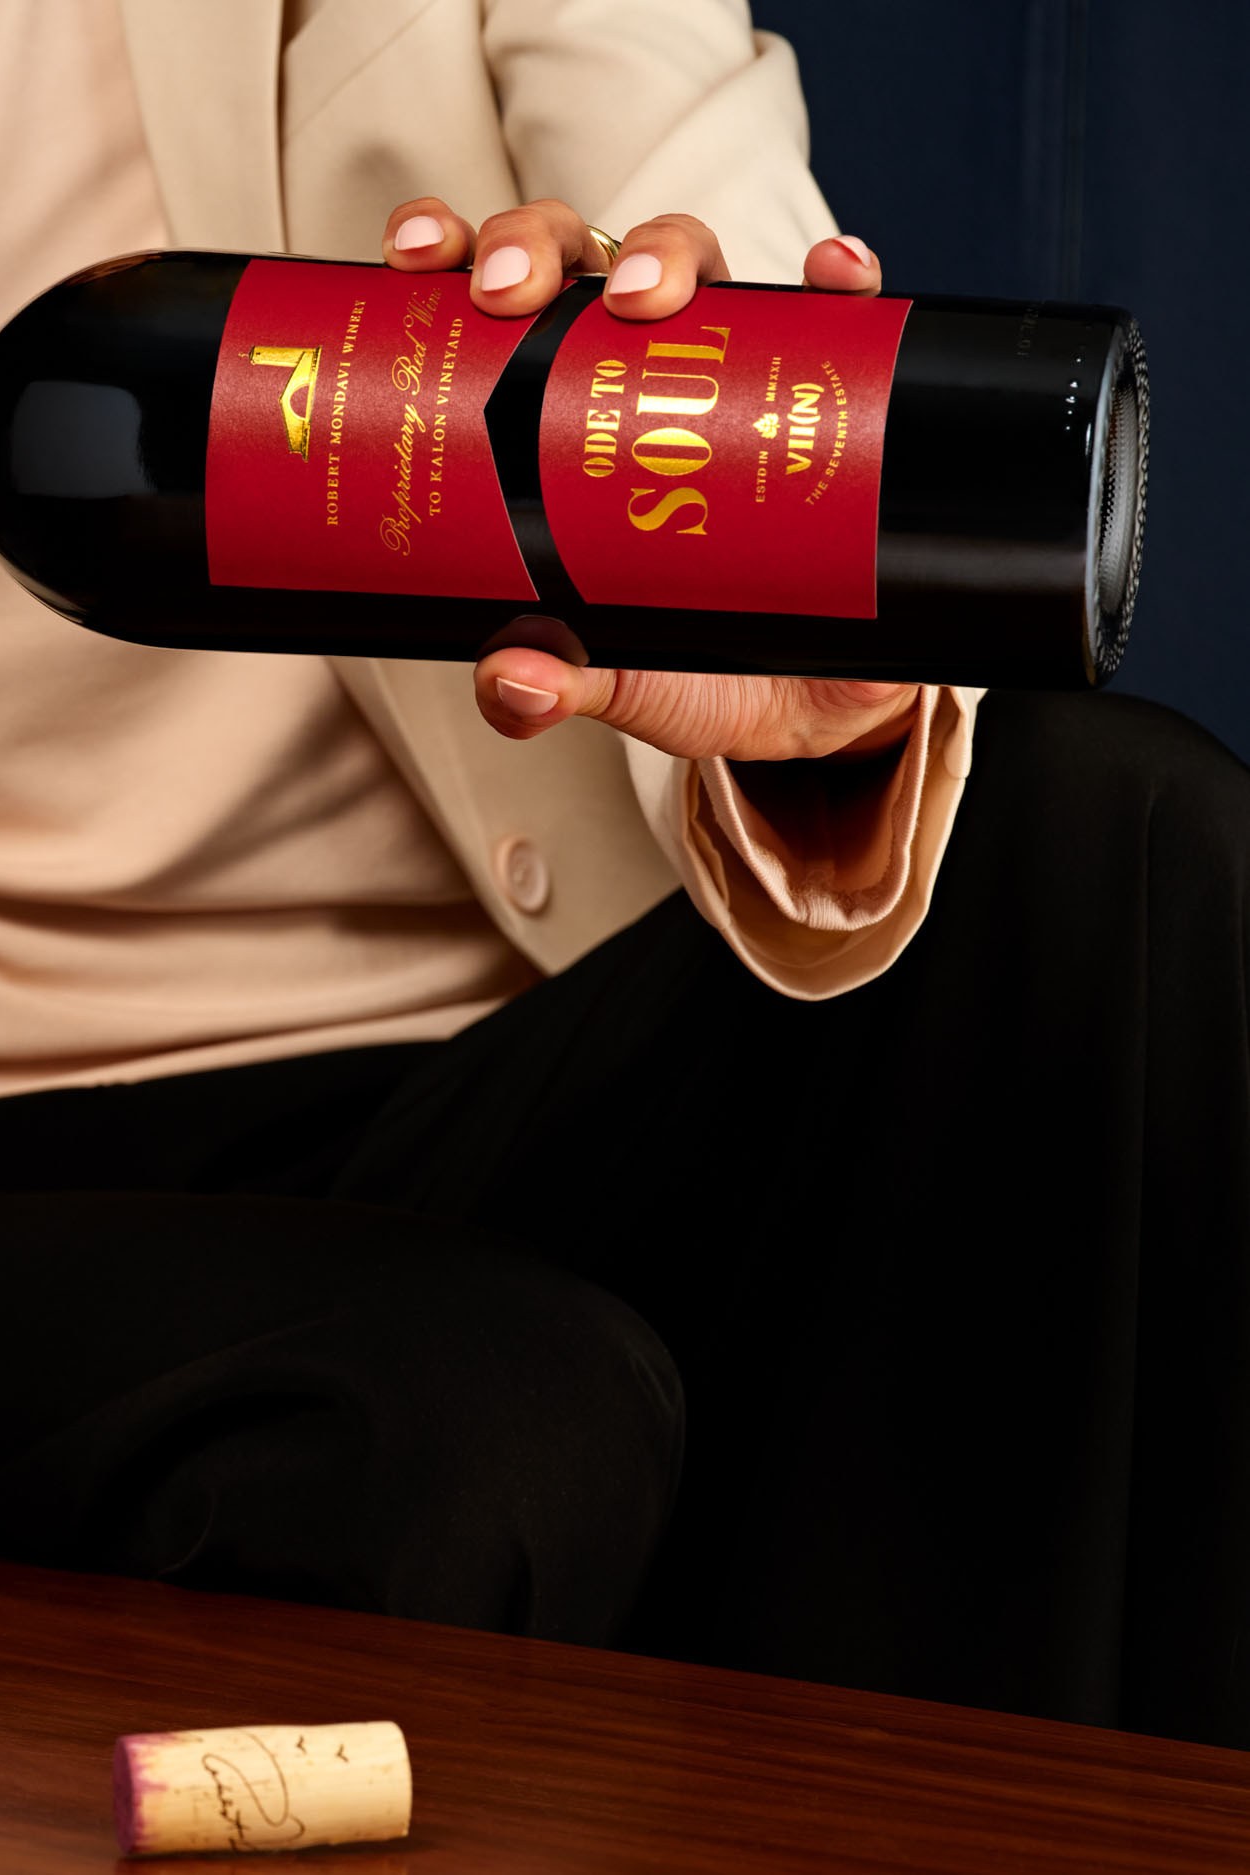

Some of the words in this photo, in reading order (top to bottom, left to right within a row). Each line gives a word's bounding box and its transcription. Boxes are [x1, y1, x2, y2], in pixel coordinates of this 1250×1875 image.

[342, 300, 367, 355] WINERY
[392, 330, 428, 396] Red
[436, 317, 464, 406] VINEYARD
[590, 359, 628, 399] TO
[765, 356, 782, 402] MMXXII
[821, 360, 847, 406] ESTATE
[329, 360, 351, 445] MONDAVI
[627, 325, 732, 536] SOUL
[785, 382, 825, 475] VII(N)
[429, 414, 447, 484] KALON
[582, 409, 621, 478] ODE
[758, 450, 769, 465] IN
[824, 410, 848, 477] SEVENTH
[326, 453, 341, 526] ROBERT
[380, 403, 426, 556] Proprietary
[429, 491, 443, 517] TO
[755, 467, 767, 503] ESTD
[805, 480, 828, 506] THE
